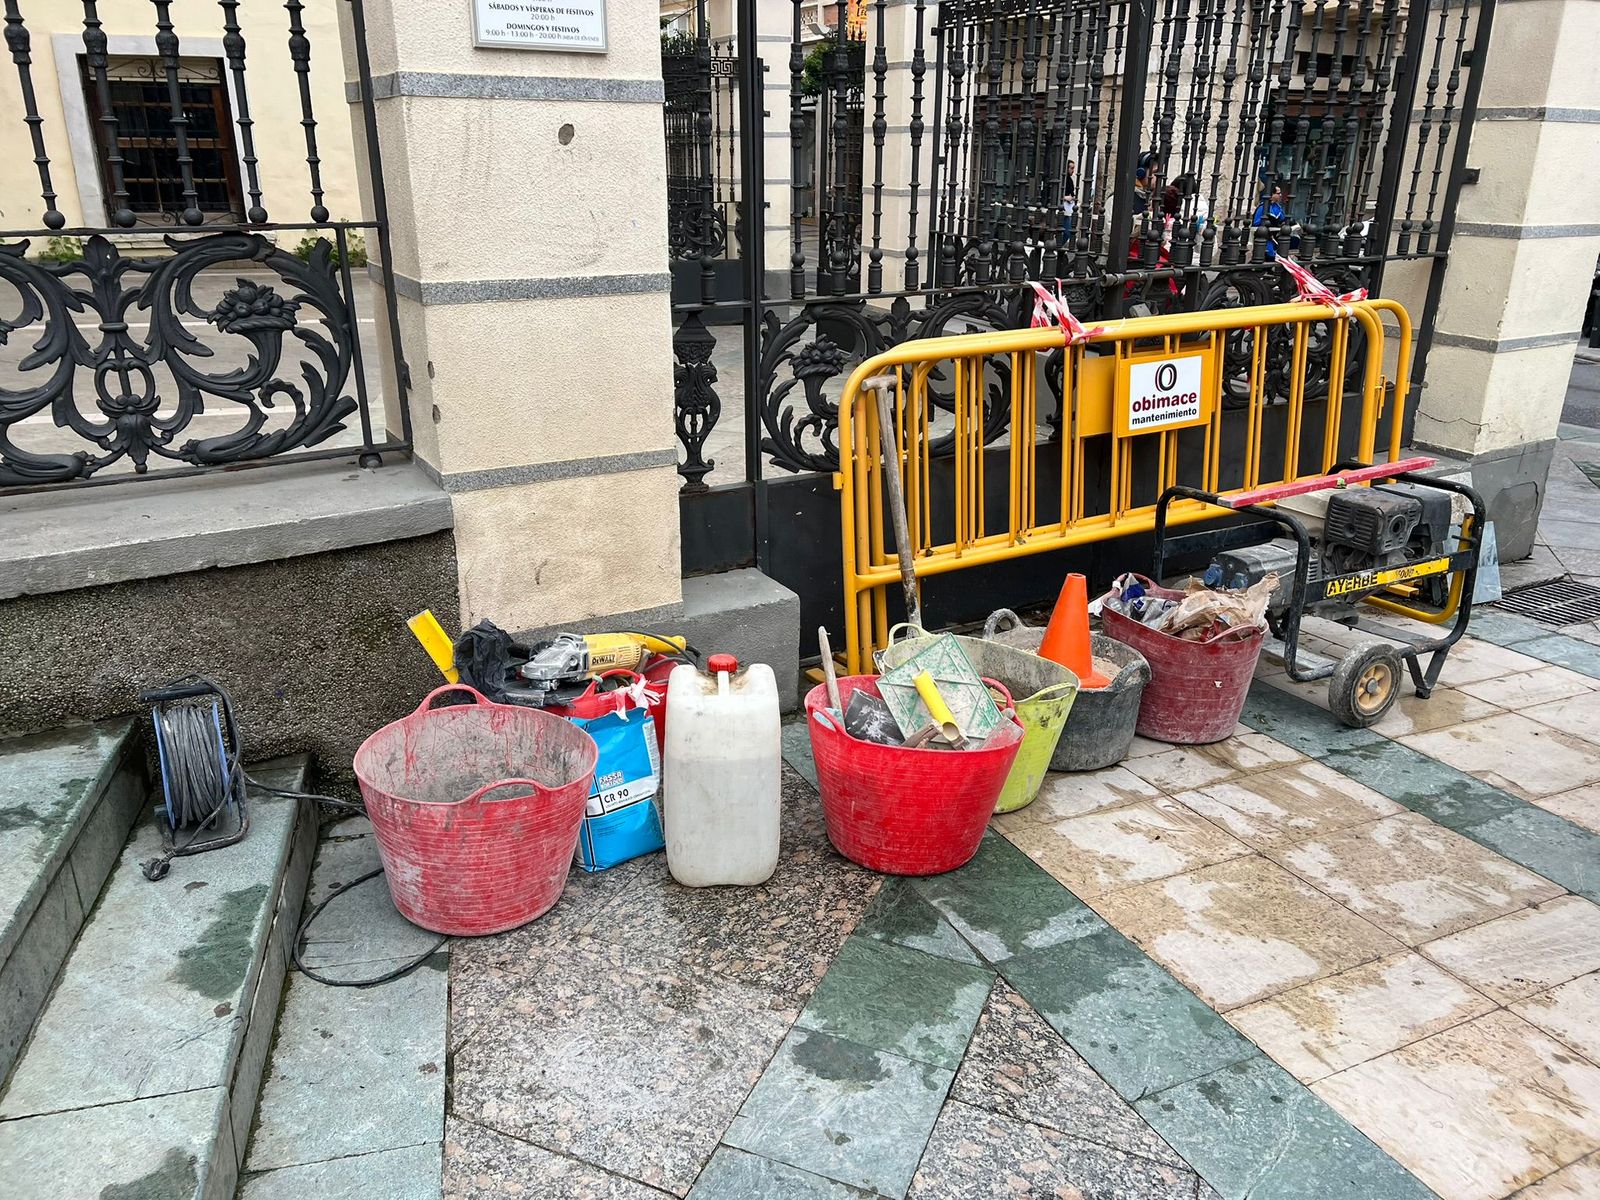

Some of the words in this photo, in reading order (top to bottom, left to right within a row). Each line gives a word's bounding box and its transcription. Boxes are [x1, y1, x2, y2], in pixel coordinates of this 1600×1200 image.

[525, 4, 555, 14] VÍSPERAS
[566, 8, 594, 16] FESTIVOS
[501, 29, 506, 37] h
[506, 23, 545, 32] DOMINGOS
[551, 26, 580, 34] FESTIVOS
[1132, 392, 1197, 413] obimace
[1131, 407, 1197, 425] mantenimiento
[1327, 571, 1378, 595] AYERBE
[604, 793, 616, 804] CR
[617, 788, 629, 799] 90
